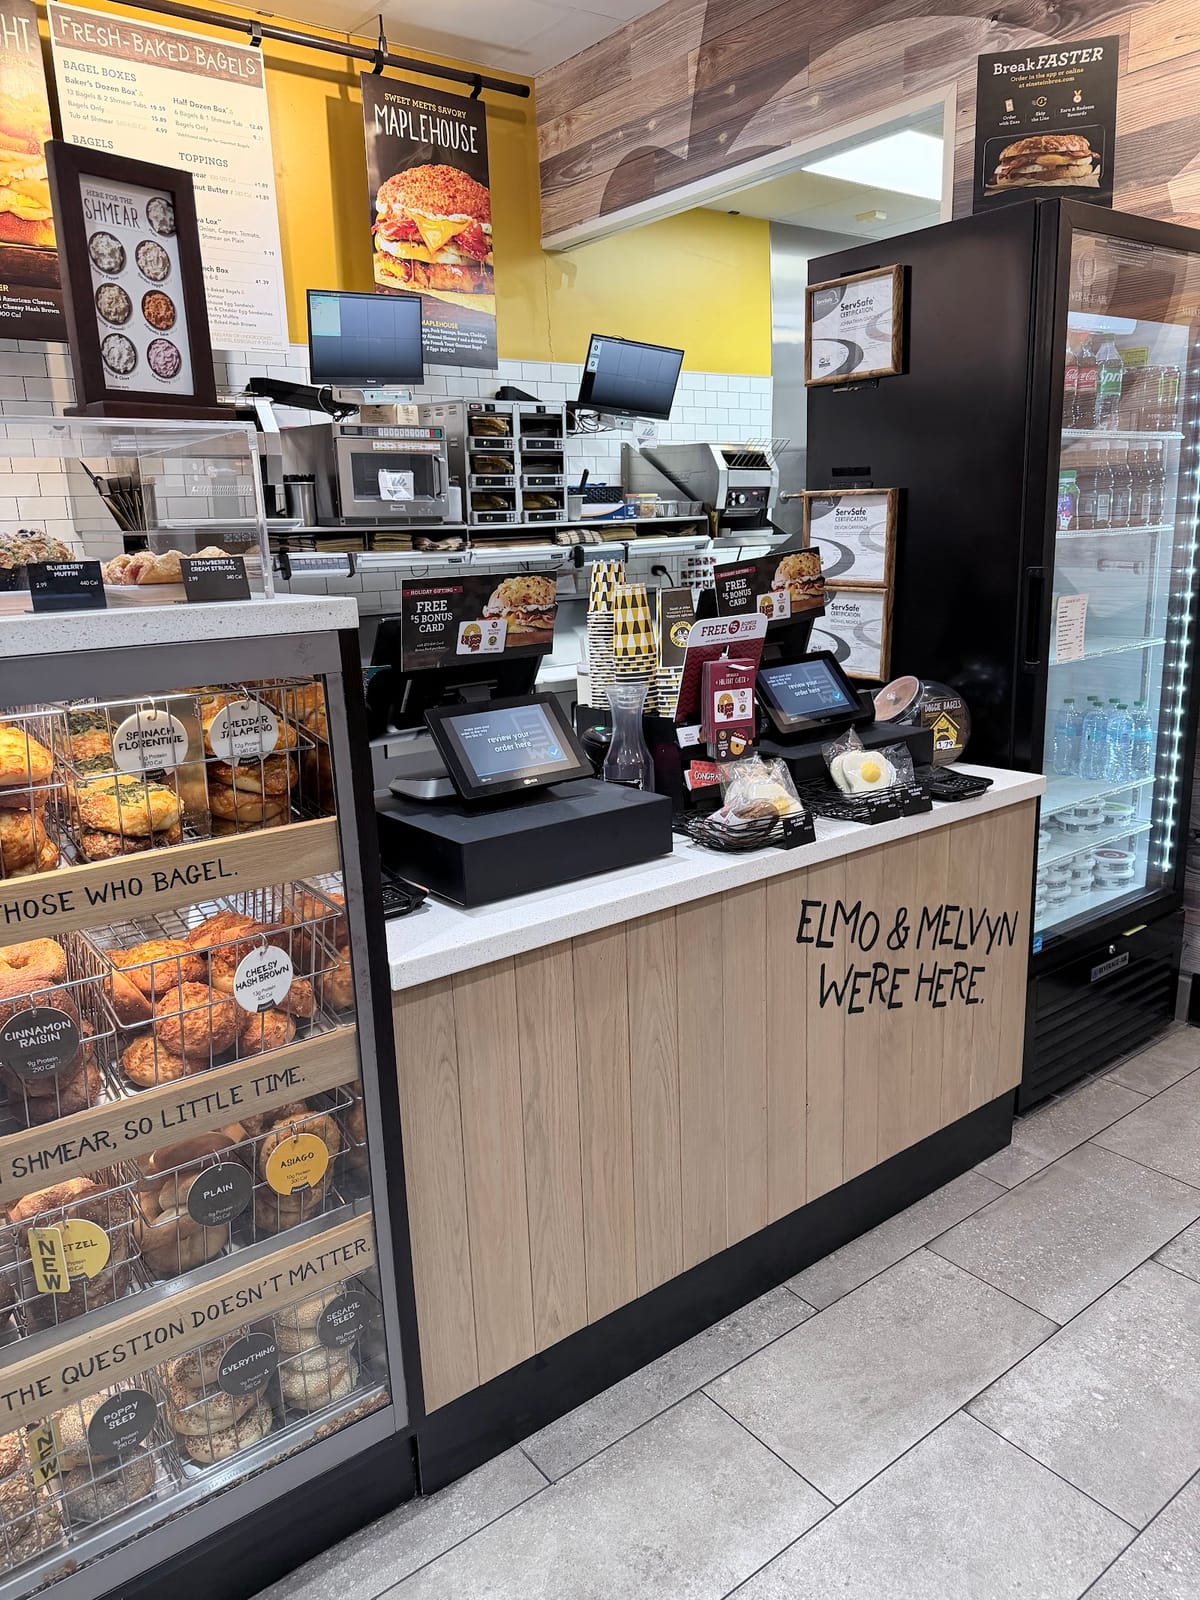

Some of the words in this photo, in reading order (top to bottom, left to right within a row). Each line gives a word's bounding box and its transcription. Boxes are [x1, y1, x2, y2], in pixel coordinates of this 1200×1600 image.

[59, 14, 190, 62] FRESH-BAKED
[193, 46, 257, 78] BAGELS
[992, 46, 1104, 76] BreakFASTER
[63, 60, 99, 75] BAGEL
[101, 67, 137, 82] BOXES
[1010, 74, 1028, 82] Order
[1066, 67, 1084, 75] online
[65, 76, 93, 88] Baker's
[95, 81, 120, 93] Dozen
[1025, 76, 1075, 88] einsteinbros.com
[90, 104, 105, 113] Only
[173, 97, 187, 106] Half
[189, 100, 212, 111] Dozen
[384, 92, 411, 106] SWEET
[412, 99, 437, 112] MEETS
[438, 105, 467, 120] SAVORY
[69, 111, 81, 119] Tub
[374, 103, 478, 154] MAPLEHOUSE
[72, 134, 114, 150] BAGELS
[178, 152, 228, 168] TOPPINGS
[86, 189, 104, 199] HERE
[118, 196, 133, 205] THE
[207, 185, 229, 195] Butter
[83, 197, 140, 229] SHMEAR
[216, 266, 229, 274] Box
[32, 298, 56, 307] Cheese,
[840, 296, 874, 312] ServSafe
[840, 305, 874, 319] CERTIFICATION
[836, 506, 867, 516] ServSafe
[834, 515, 868, 523] CERTIFICATION
[46, 563, 84, 571] BLUEBERRY
[190, 559, 229, 567] STRAWBERRY
[53, 570, 78, 578] MUFFIN
[410, 588, 433, 596] HOLIDAY
[725, 578, 748, 591] FREE
[722, 592, 730, 600] $5
[729, 589, 752, 599] BONUS
[729, 597, 747, 607] CARD
[416, 599, 448, 613] FREE
[830, 602, 861, 612] ServSafe
[410, 615, 420, 624] $5
[421, 612, 453, 623] BONUS
[418, 623, 445, 633] CARD
[700, 623, 728, 637] FREE
[788, 682, 805, 690] review
[943, 699, 961, 710] BAGELS
[222, 715, 269, 730] CHEDDAR
[126, 727, 175, 741] SPINACH
[487, 734, 512, 744] review
[512, 731, 529, 740] your
[118, 735, 185, 751] FLORENTINE
[494, 743, 514, 753] order
[515, 740, 532, 749] here
[84, 877, 143, 906] WHO
[151, 858, 239, 892] BAGEL.
[796, 899, 880, 952] ELMO
[886, 906, 911, 951] &
[916, 903, 1019, 956] MELVYN
[245, 960, 278, 978] CHEESY
[235, 977, 258, 992] HASH
[259, 964, 290, 983] BROWN
[819, 961, 910, 1015] WERE
[914, 960, 985, 1009] HERE.
[4, 1019, 71, 1041] CINNAMON
[19, 1031, 61, 1049] RAISIN
[36, 1056, 59, 1065] Protein
[11, 1130, 118, 1178] SHMEAR,
[124, 1117, 153, 1141] SO
[161, 1084, 243, 1129] LITTLE
[250, 1065, 306, 1098] TIME.
[280, 1151, 314, 1169] ASIAGO
[203, 1182, 233, 1200] PLAIN
[38, 1240, 61, 1291] NEW
[326, 1301, 361, 1322] SESAME
[333, 1311, 355, 1327] SEED
[0, 1375, 53, 1411] THE
[61, 1321, 185, 1387] QUESTION
[192, 1273, 283, 1329] DOESN'T
[289, 1238, 371, 1286] MATTER.
[222, 1344, 275, 1376] EVERYTHING
[103, 1400, 139, 1423] POPPY
[108, 1411, 136, 1430] SEED
